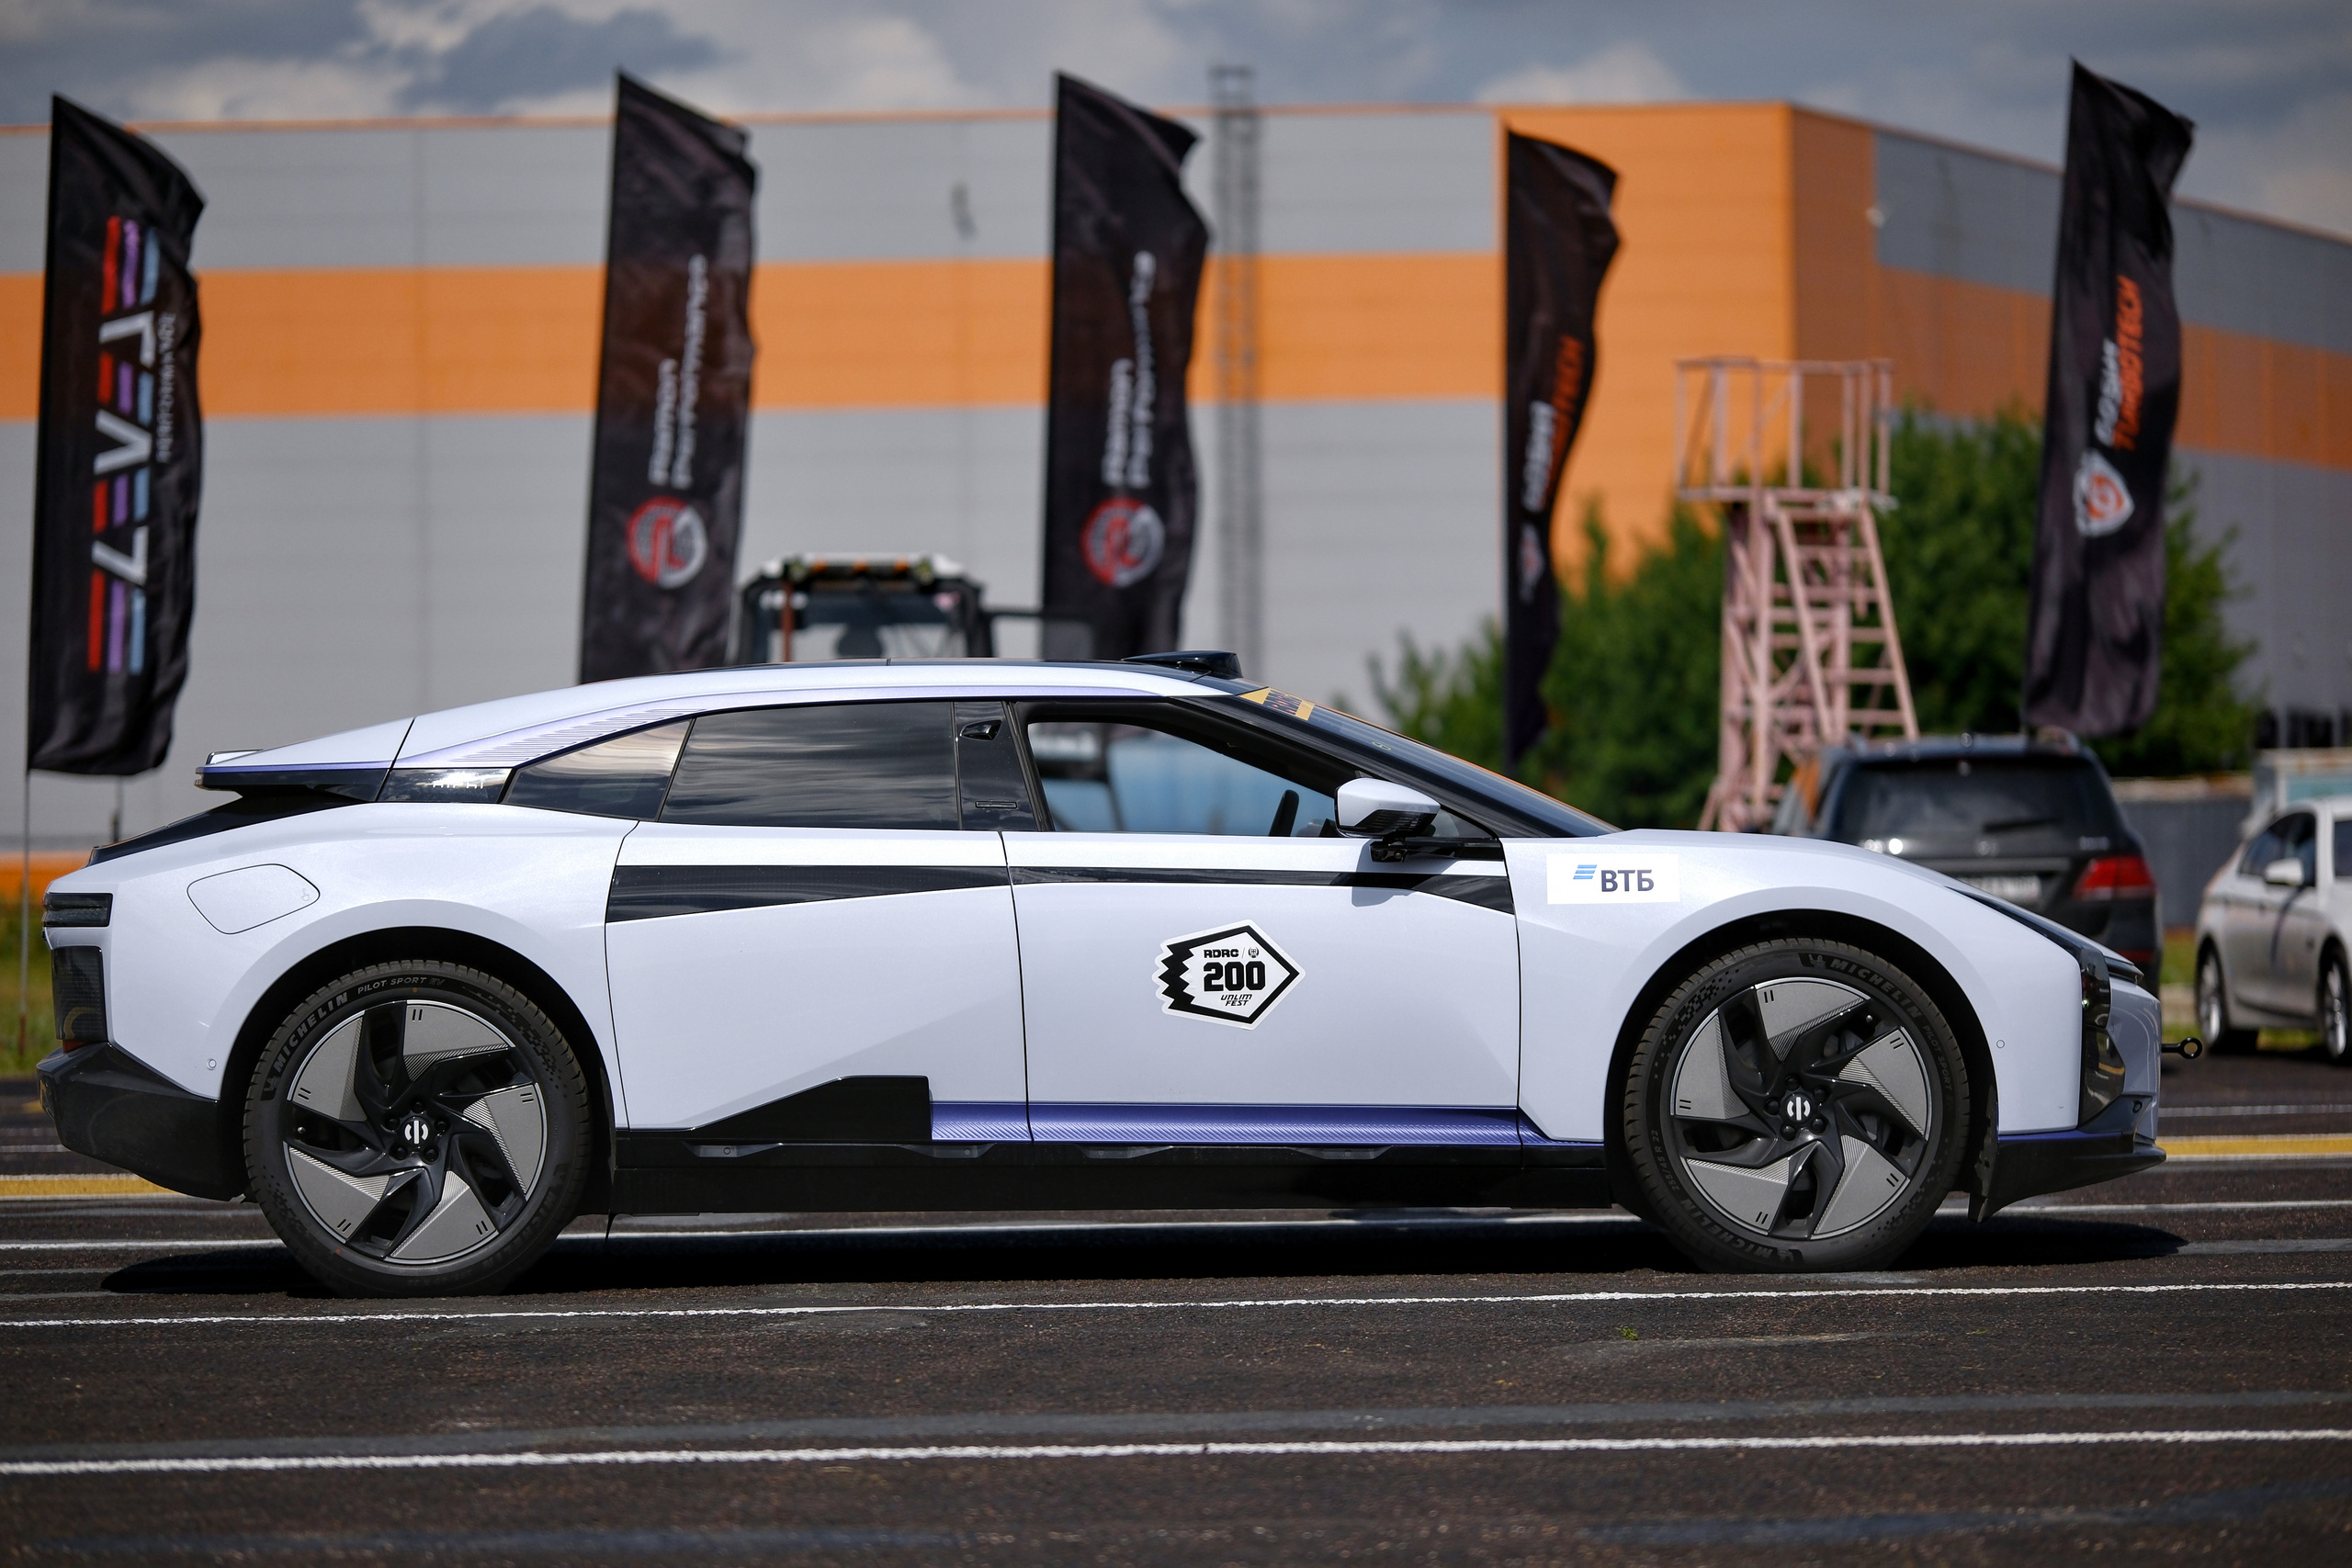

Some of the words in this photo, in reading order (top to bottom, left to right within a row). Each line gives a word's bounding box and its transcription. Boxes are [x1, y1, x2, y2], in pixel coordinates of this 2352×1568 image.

[1600, 869, 1655, 893] ВТБ
[1203, 949, 1239, 959] RDRC
[1203, 961, 1266, 992] 200
[273, 990, 349, 1075] MICHELIN
[357, 979, 388, 995] PILOT
[390, 976, 427, 987] SPORT
[1829, 958, 1922, 1021] MICHELIN
[1922, 1024, 1942, 1054] PILOT
[1937, 1055, 1953, 1092] SPORT
[1650, 1129, 1661, 1143] 22
[1657, 1155, 1681, 1191] 255/45
[1679, 1198, 1773, 1259] MICHELIN
